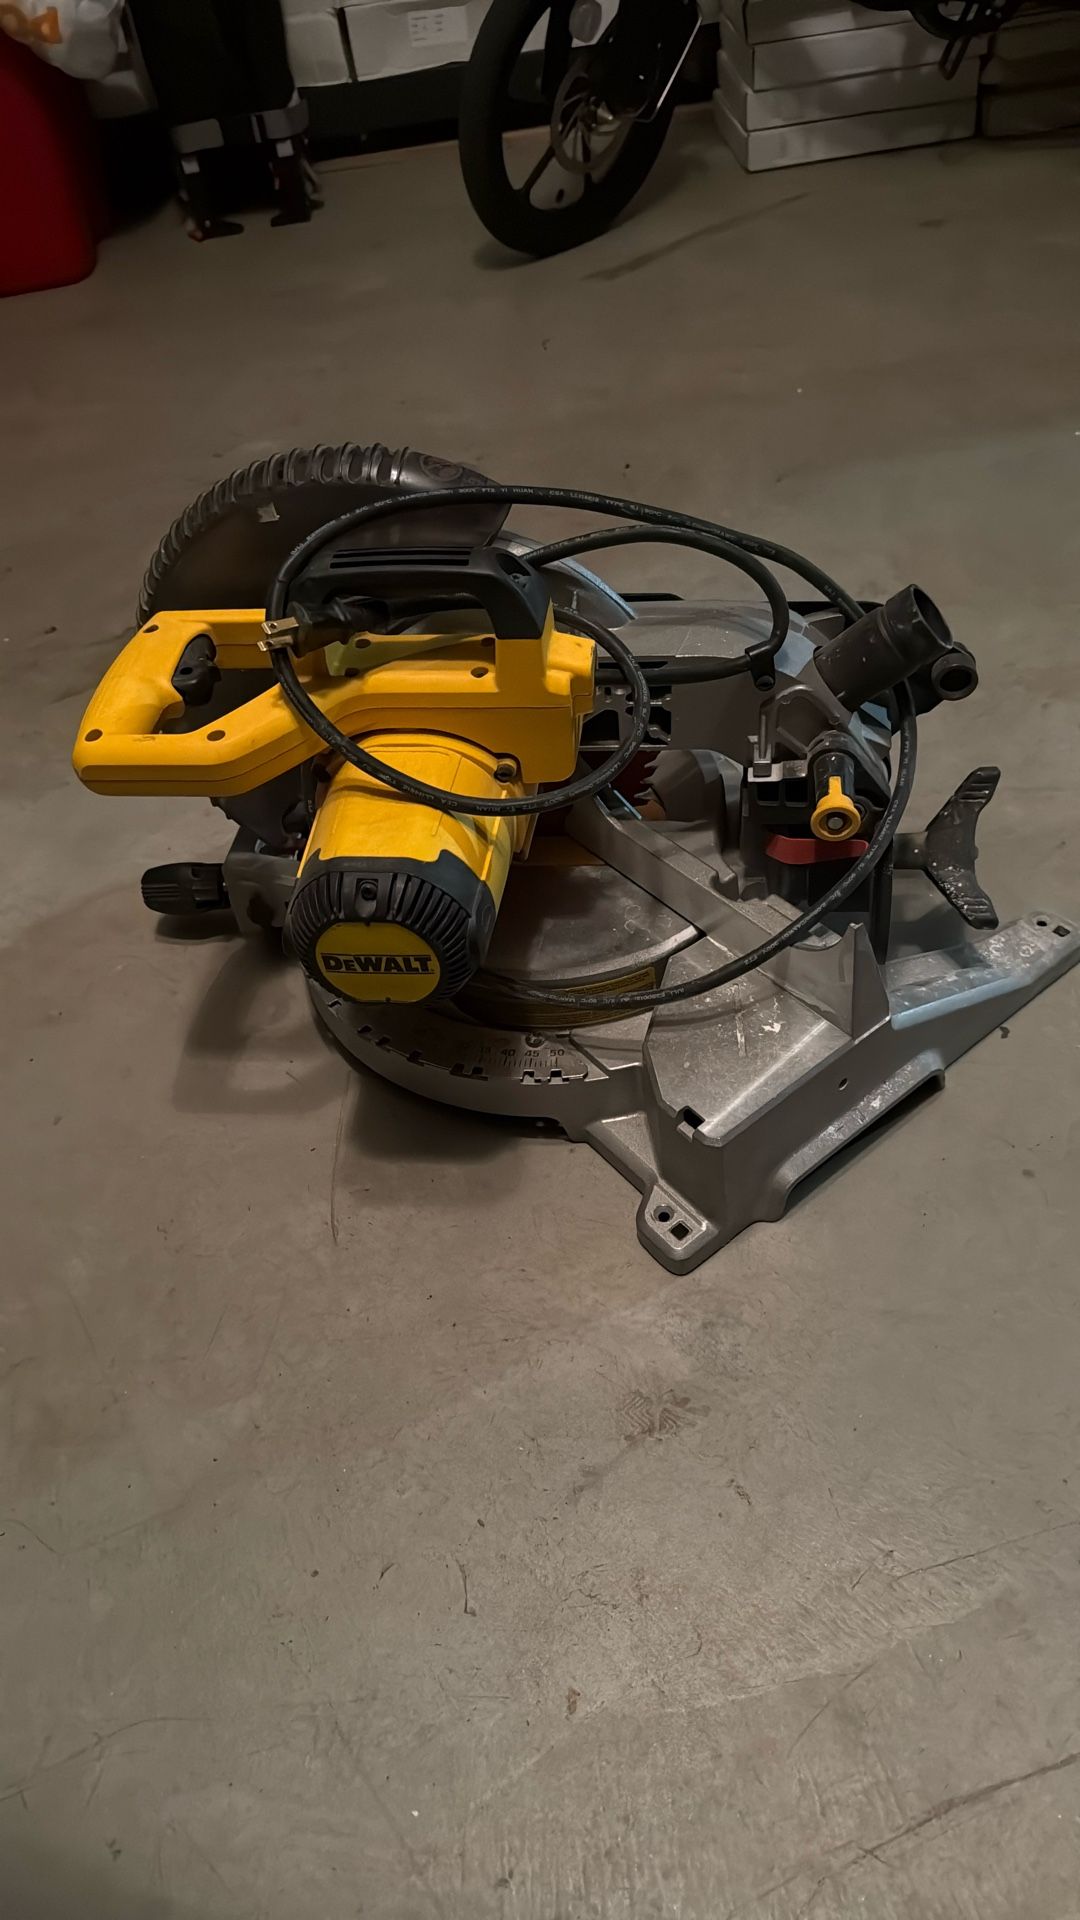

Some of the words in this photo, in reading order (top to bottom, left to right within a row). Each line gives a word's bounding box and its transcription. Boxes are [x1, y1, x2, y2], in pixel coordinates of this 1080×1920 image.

[500, 1048, 516, 1057] 40
[524, 1048, 540, 1058] 45
[549, 1048, 565, 1057] 50
